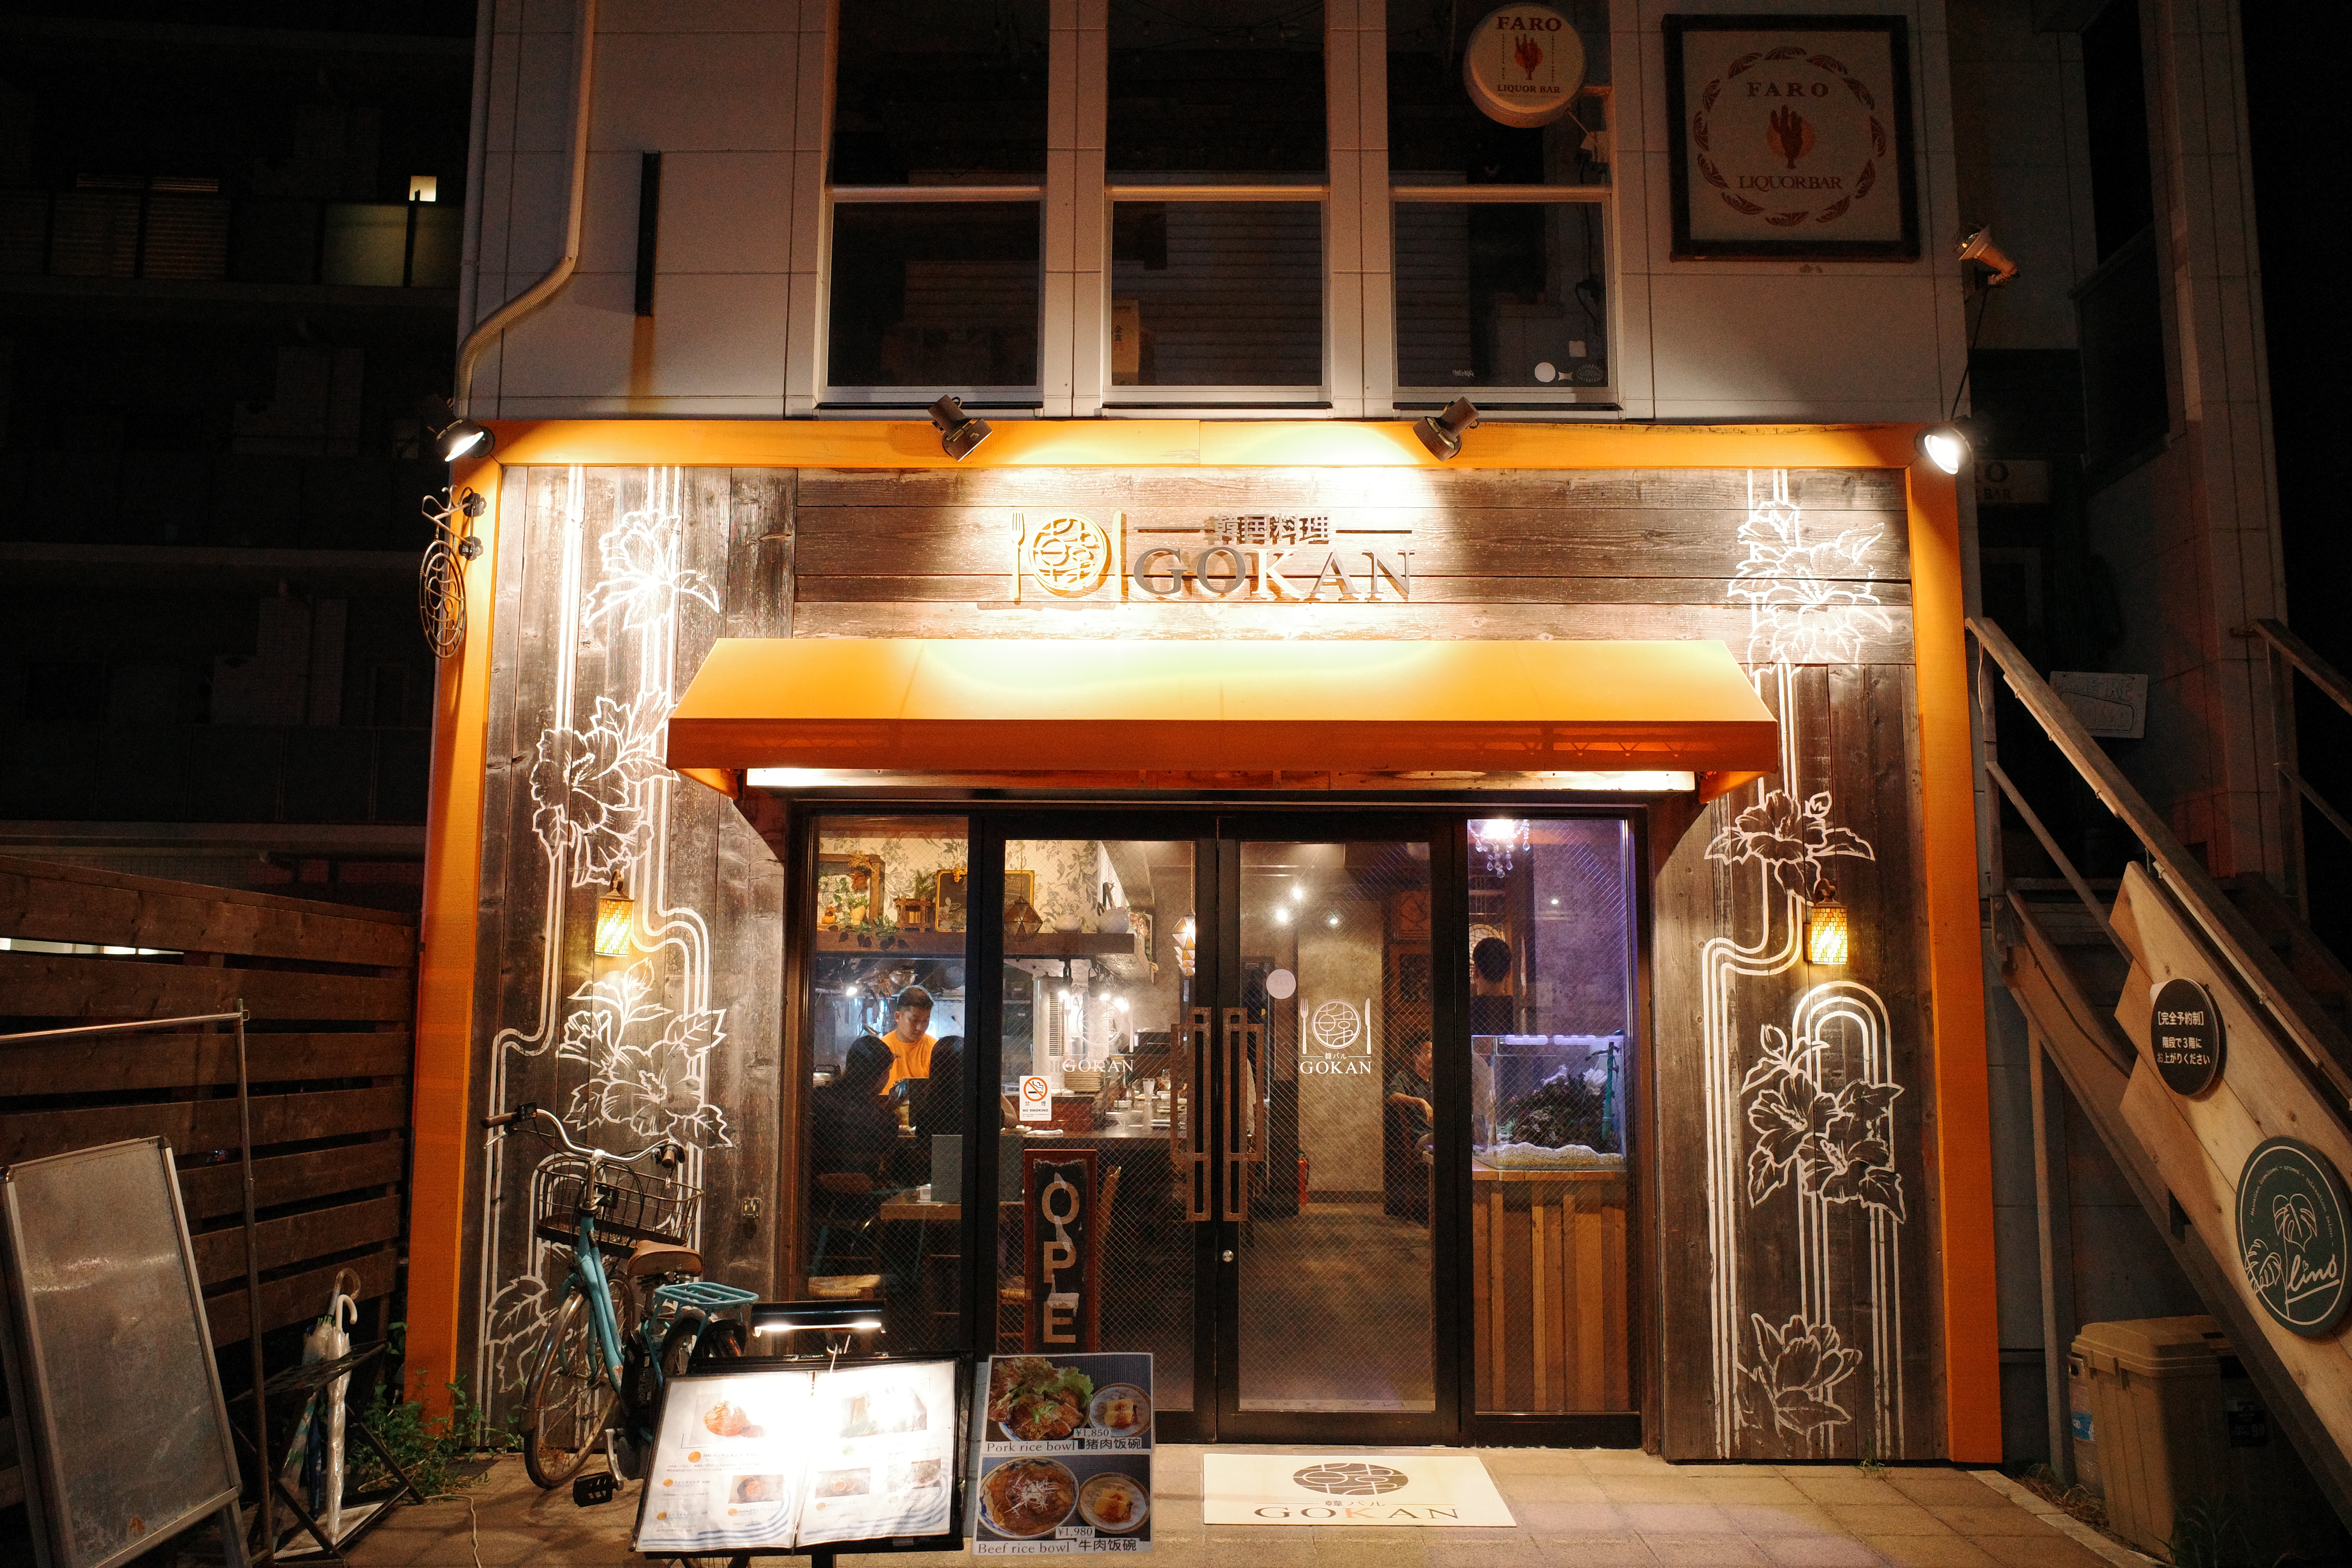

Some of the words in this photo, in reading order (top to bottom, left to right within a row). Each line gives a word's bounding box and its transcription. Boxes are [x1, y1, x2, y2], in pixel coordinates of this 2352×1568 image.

[1497, 16, 1562, 31] FARO
[1497, 84, 1537, 93] LIQUOR
[1746, 82, 1829, 98] FARO
[1215, 513, 1332, 542] 韓国料理
[1133, 546, 1415, 595] GOKAN
[2157, 1052, 2210, 1065] お上がりください
[1062, 1059, 1134, 1072] GOKAN
[1300, 1061, 1372, 1074] GOKAN
[1041, 1180, 1080, 1344] OPE
[1075, 1428, 1109, 1437] ¥1,850
[986, 1442, 1015, 1452] Pork
[1020, 1442, 1042, 1452] rice
[1046, 1441, 1075, 1451] bowl
[1085, 1438, 1142, 1450] 猪肉饭碗
[1254, 1506, 1459, 1519] GOKAN
[1058, 1527, 1093, 1536] ¥1,980
[978, 1543, 1007, 1554] Beef
[1011, 1543, 1035, 1553] rice
[1040, 1541, 1070, 1553] bowl
[1078, 1538, 1137, 1552] 牛肉饭碗
